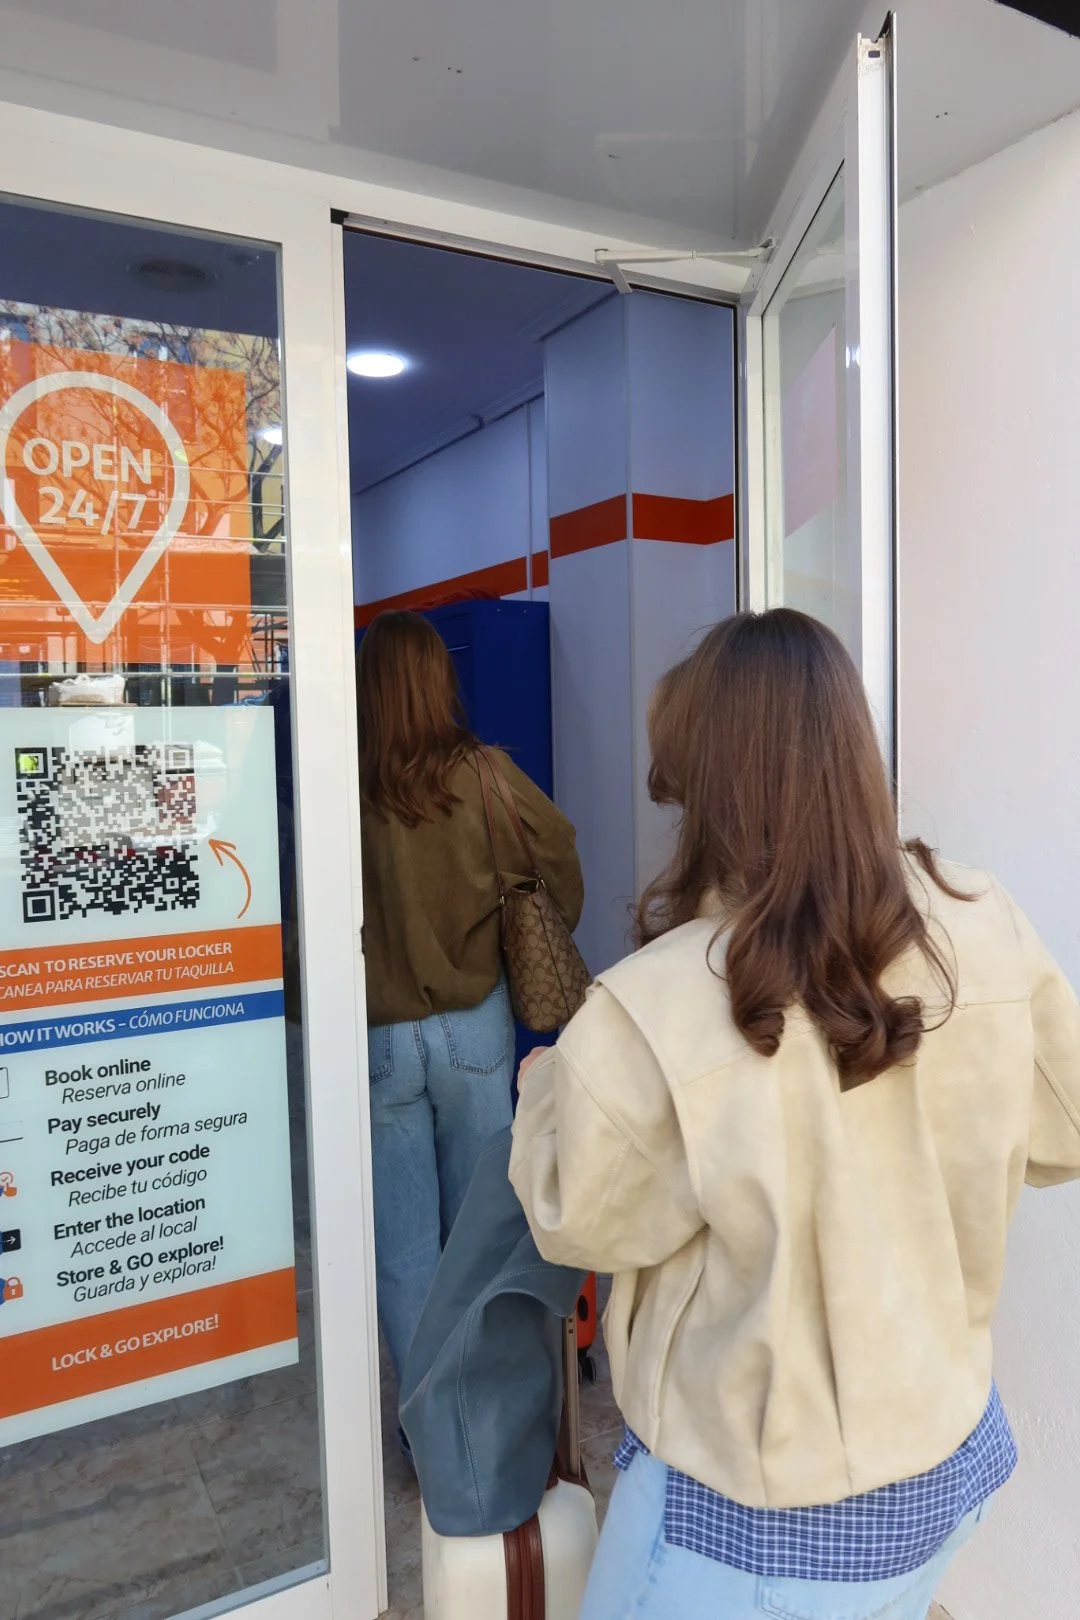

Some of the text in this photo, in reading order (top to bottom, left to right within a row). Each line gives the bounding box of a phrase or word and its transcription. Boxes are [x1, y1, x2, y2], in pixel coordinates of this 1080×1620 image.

[23, 437, 151, 484] OPEN
[38, 486, 148, 536] 24/7
[0, 942, 232, 978] SCAN TO RESERVE YOUR LOCKER
[45, 979, 83, 994] PARA
[85, 970, 153, 989] RESERVAR
[155, 967, 173, 981] TU
[174, 961, 234, 980] TAQUILLA
[37, 1026, 53, 1042] IT
[54, 1018, 116, 1039] WORKS
[129, 1010, 173, 1029] CÓMO
[174, 1001, 245, 1024] FUNCIONA
[45, 1058, 152, 1087] Book online
[61, 1071, 186, 1104] Reserva online
[47, 1102, 161, 1135] Pay securely
[65, 1110, 248, 1156] Paga de forma segura
[50, 1144, 211, 1186] Receive your code
[68, 1170, 208, 1208] Recibe tu código
[53, 1198, 206, 1241] Enter the location
[70, 1216, 198, 1258] Accede al local
[56, 1236, 224, 1288] Store & GO explore!
[73, 1256, 216, 1302] Guarda y explora!
[51, 1314, 219, 1371] LOCK & GO EXPLORE!
